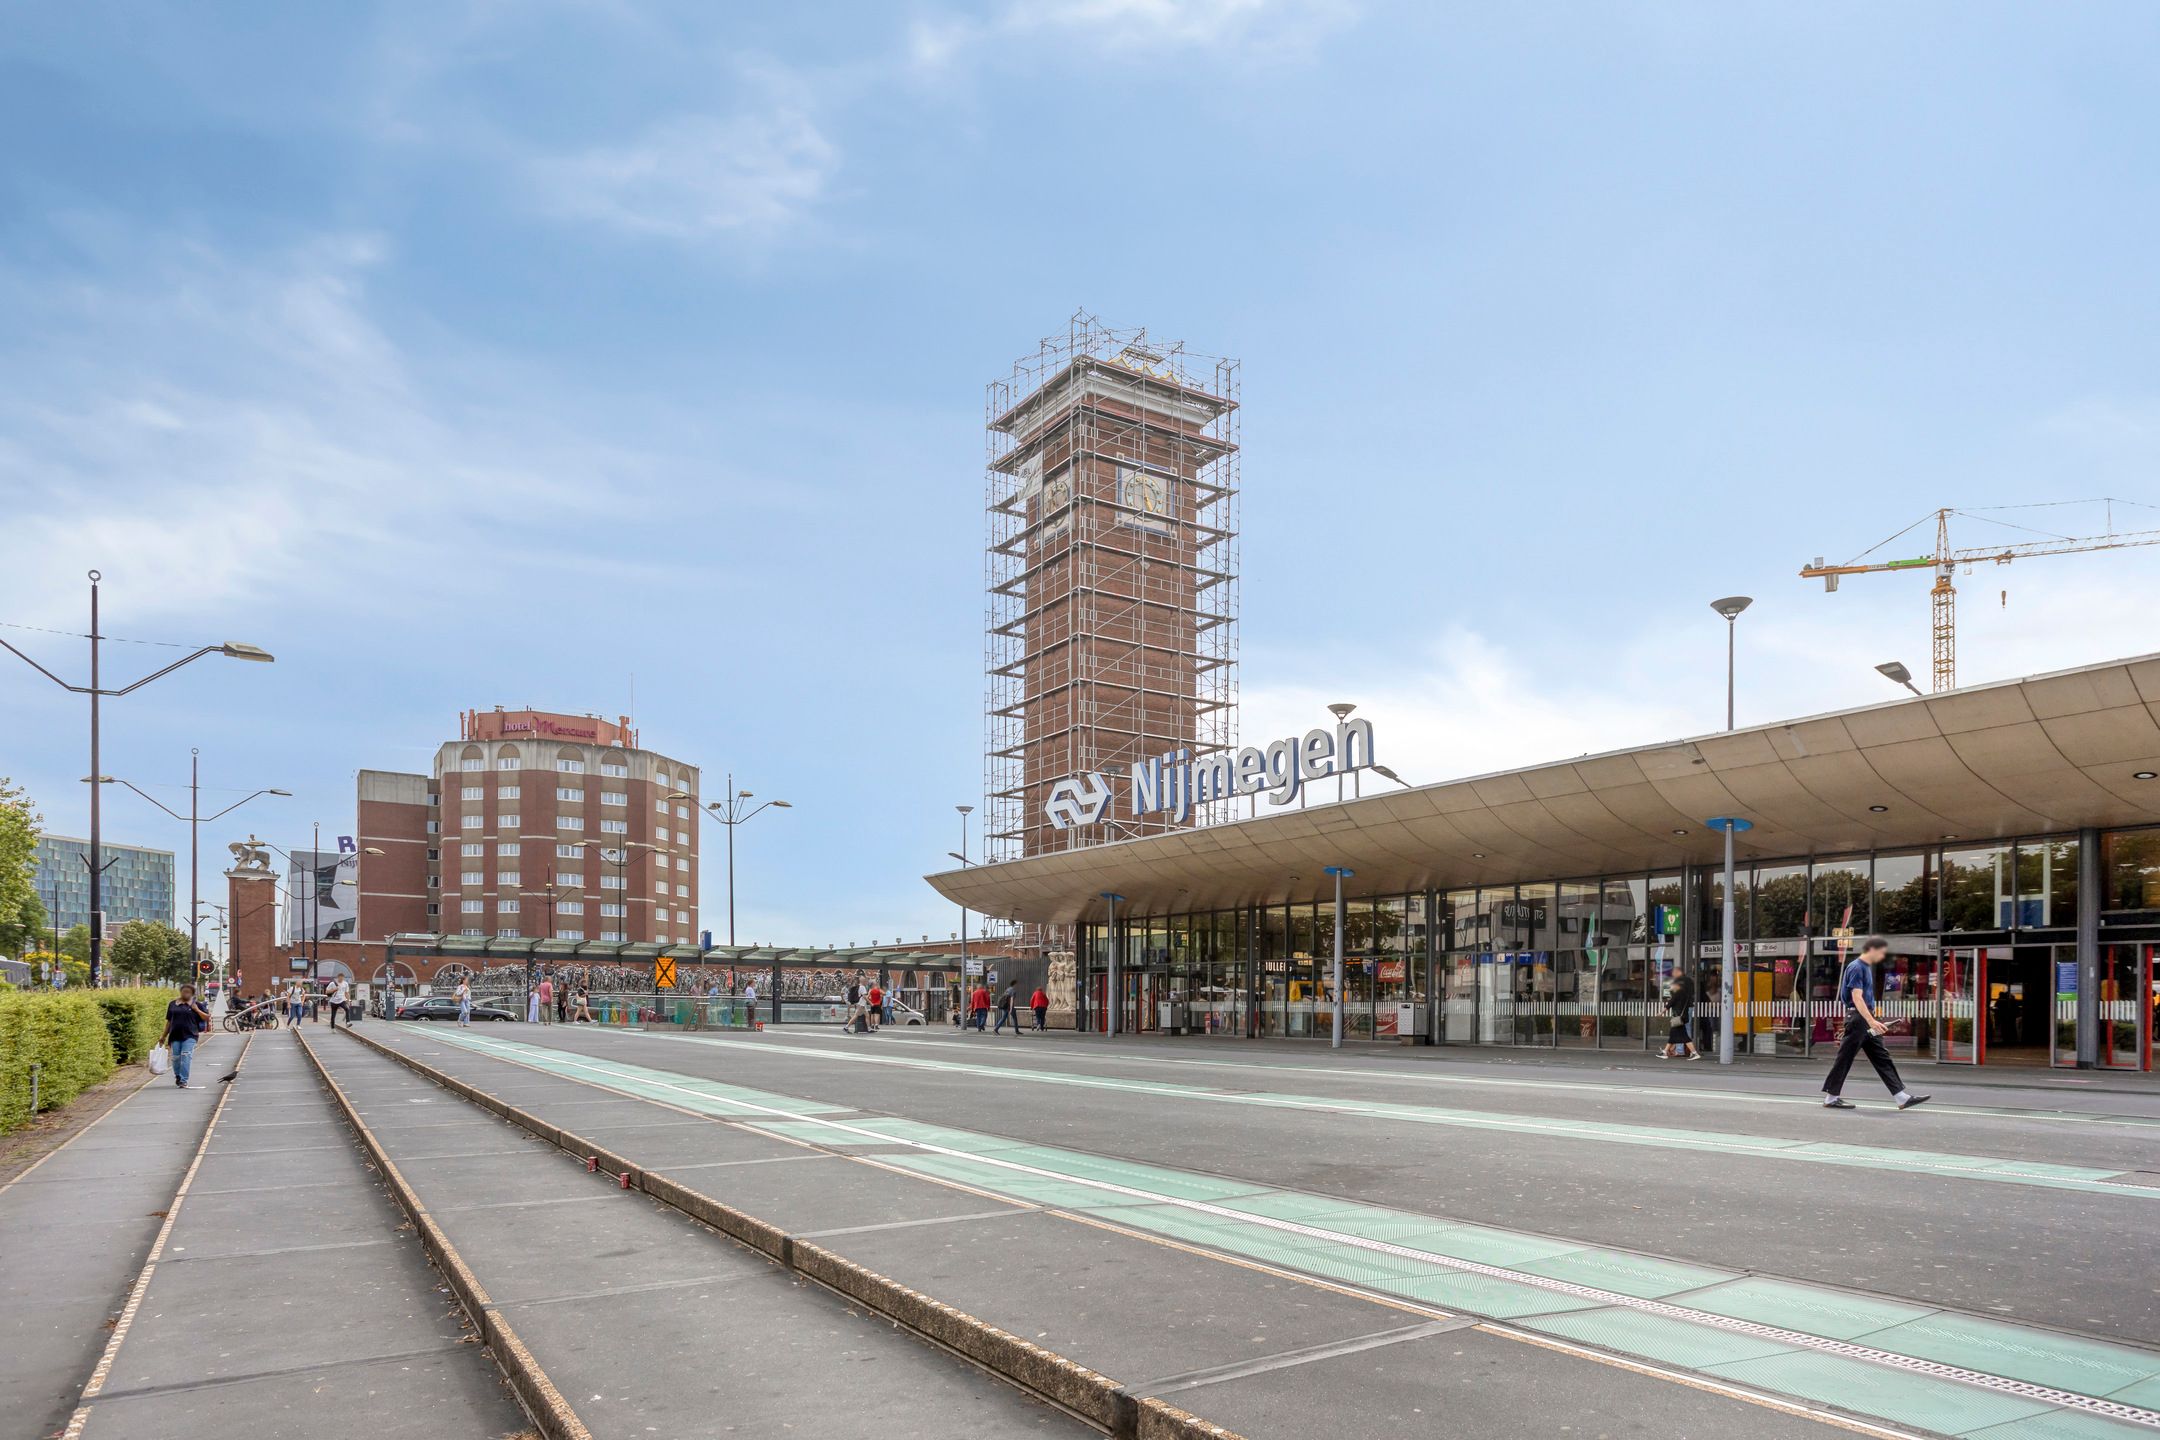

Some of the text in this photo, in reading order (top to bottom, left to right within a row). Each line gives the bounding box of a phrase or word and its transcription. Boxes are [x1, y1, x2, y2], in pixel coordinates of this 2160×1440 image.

[504, 716, 597, 738] hotel Mercure
[1131, 718, 1374, 824] Nijmegen
